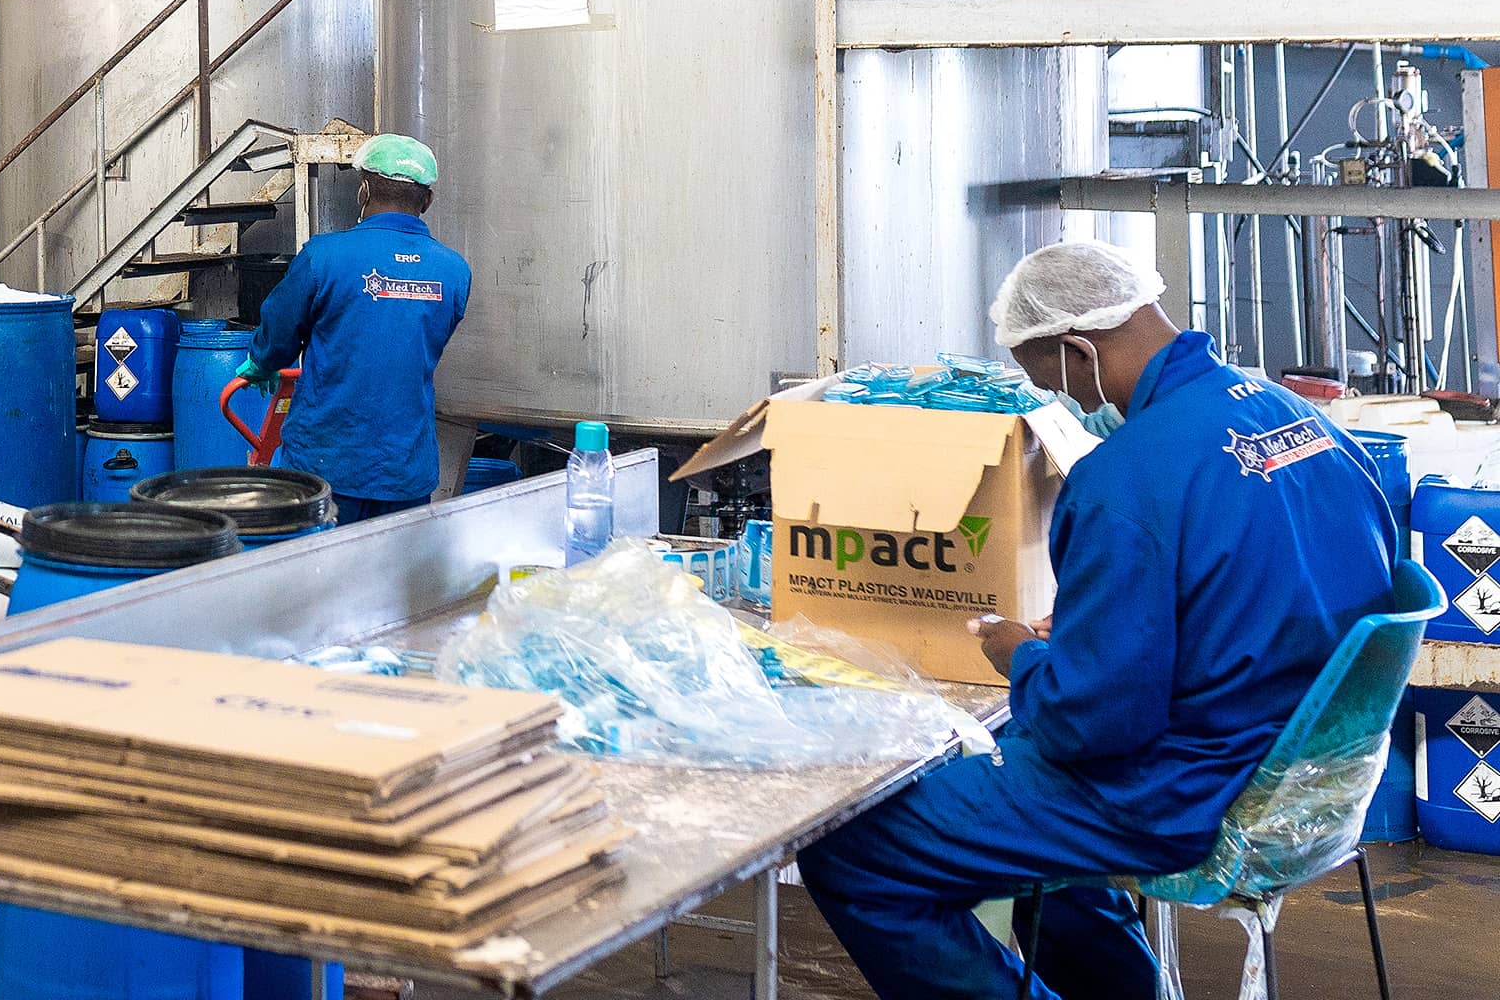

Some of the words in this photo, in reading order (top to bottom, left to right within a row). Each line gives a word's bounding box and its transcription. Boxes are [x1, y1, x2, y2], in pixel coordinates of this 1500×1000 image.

[394, 253, 421, 262] ERIC
[385, 282, 408, 292] Med
[409, 283, 433, 293] Tech
[1259, 435, 1289, 456] Med
[1284, 425, 1318, 448] Tech
[790, 525, 957, 572] mpact
[1457, 545, 1497, 555] CORROSIVE
[788, 573, 835, 590] MPACT
[839, 579, 907, 598] PLASTICS
[911, 586, 997, 606] WADEVILLE
[1460, 726, 1500, 736] CORROSIVE
